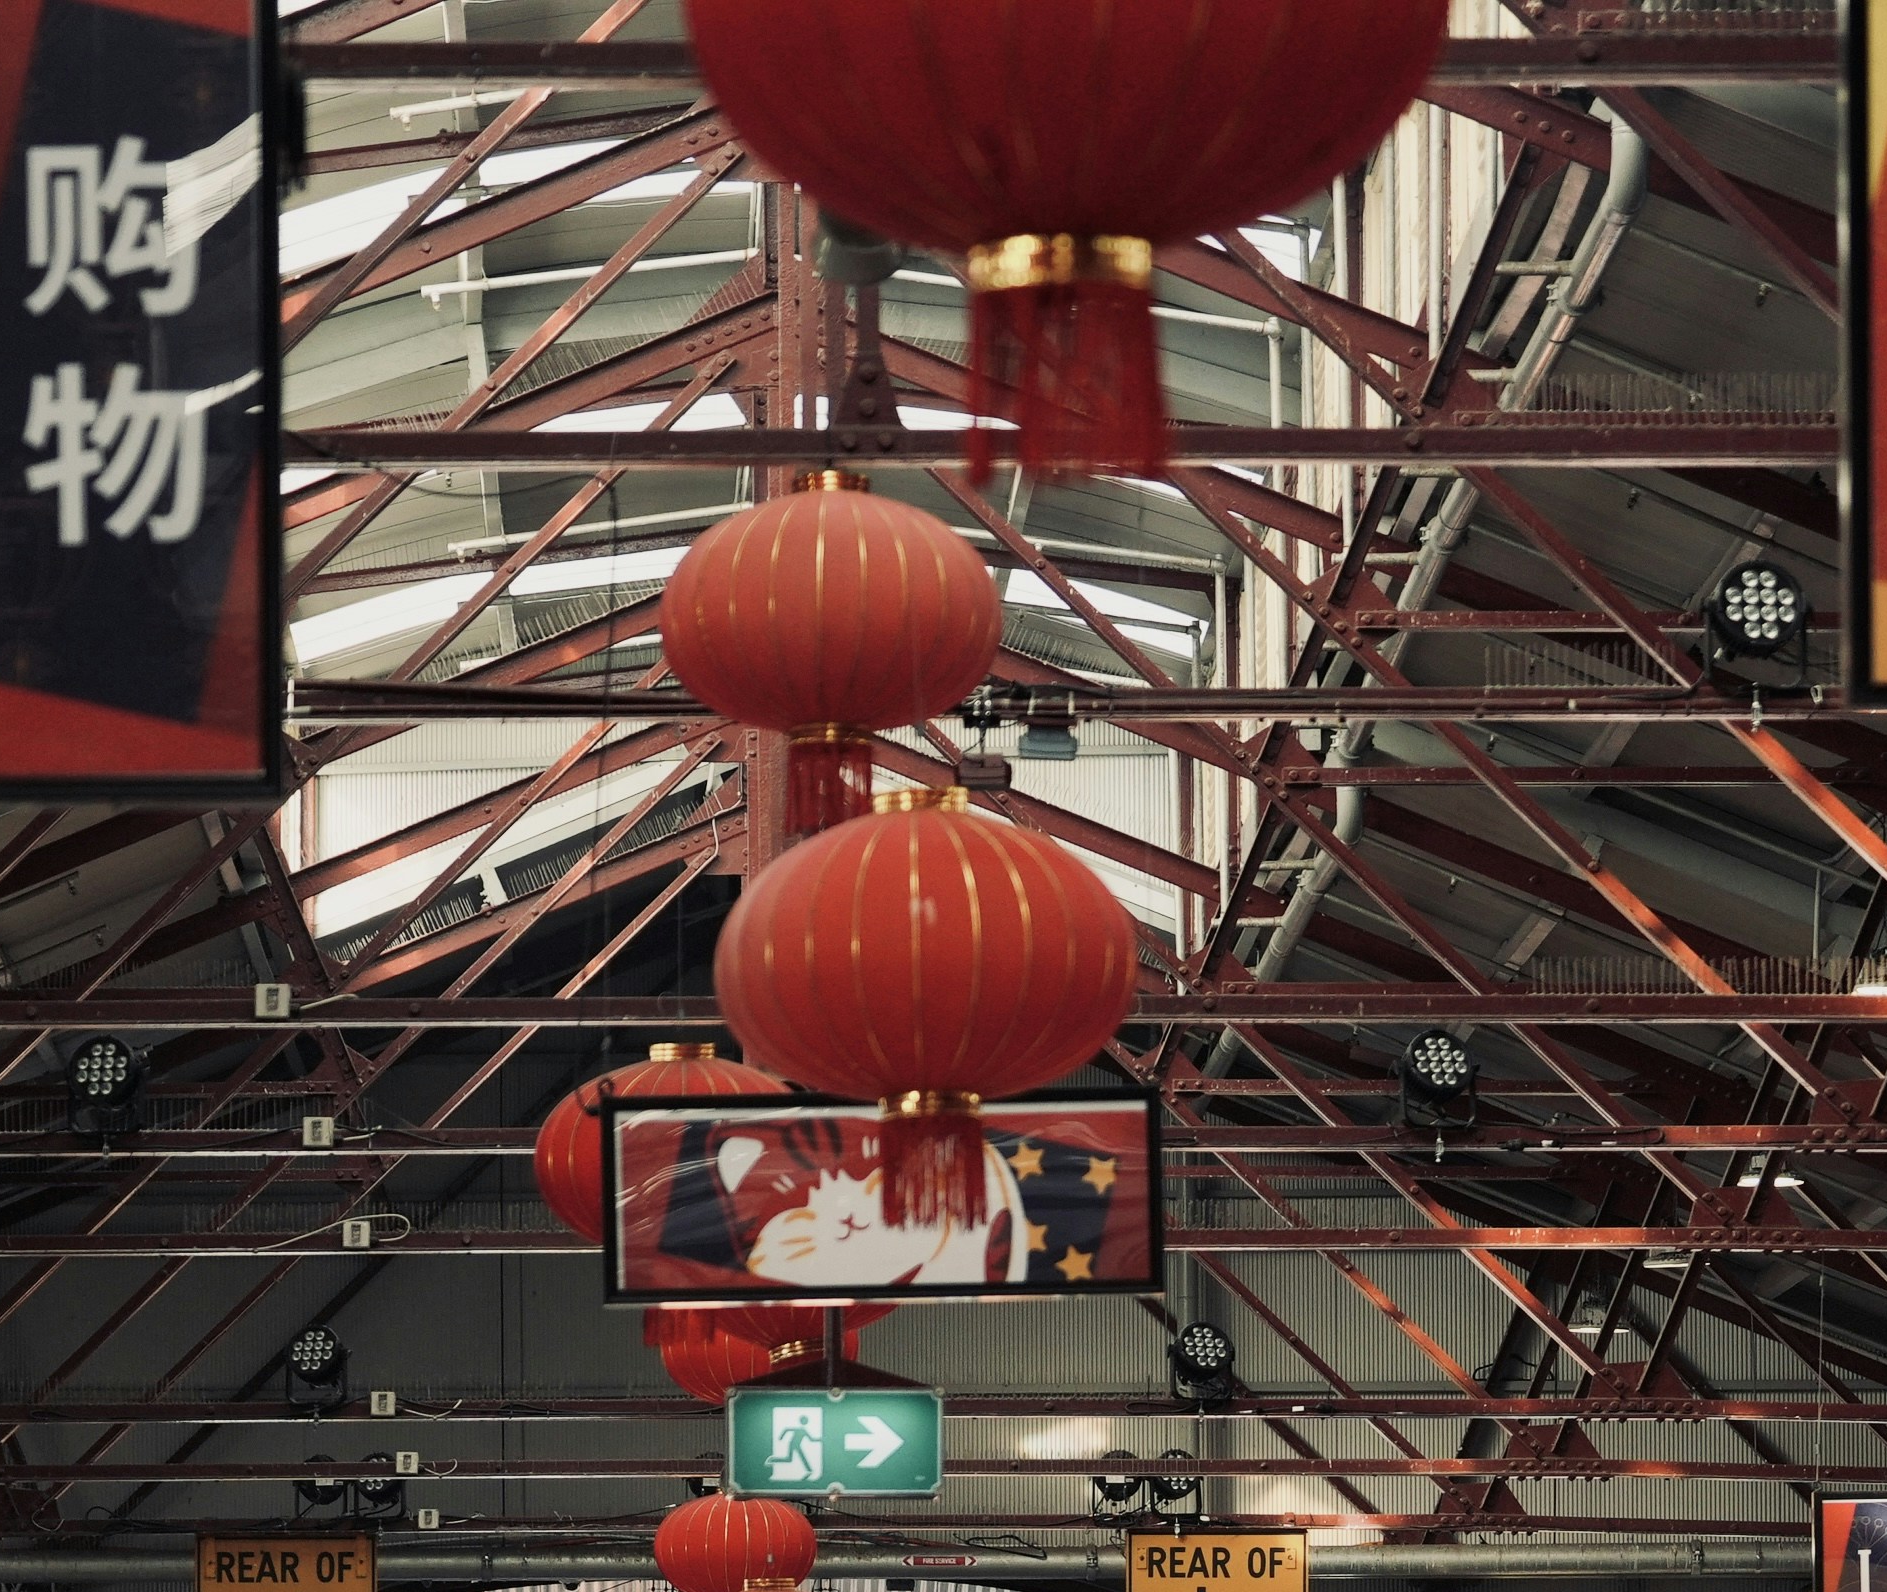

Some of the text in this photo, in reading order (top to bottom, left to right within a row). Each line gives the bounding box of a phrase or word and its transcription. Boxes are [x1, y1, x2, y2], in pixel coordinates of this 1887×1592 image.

[23, 134, 207, 548] 购物
[216, 1551, 355, 1583] REAR OF
[1147, 1546, 1286, 1579] REAR OF
